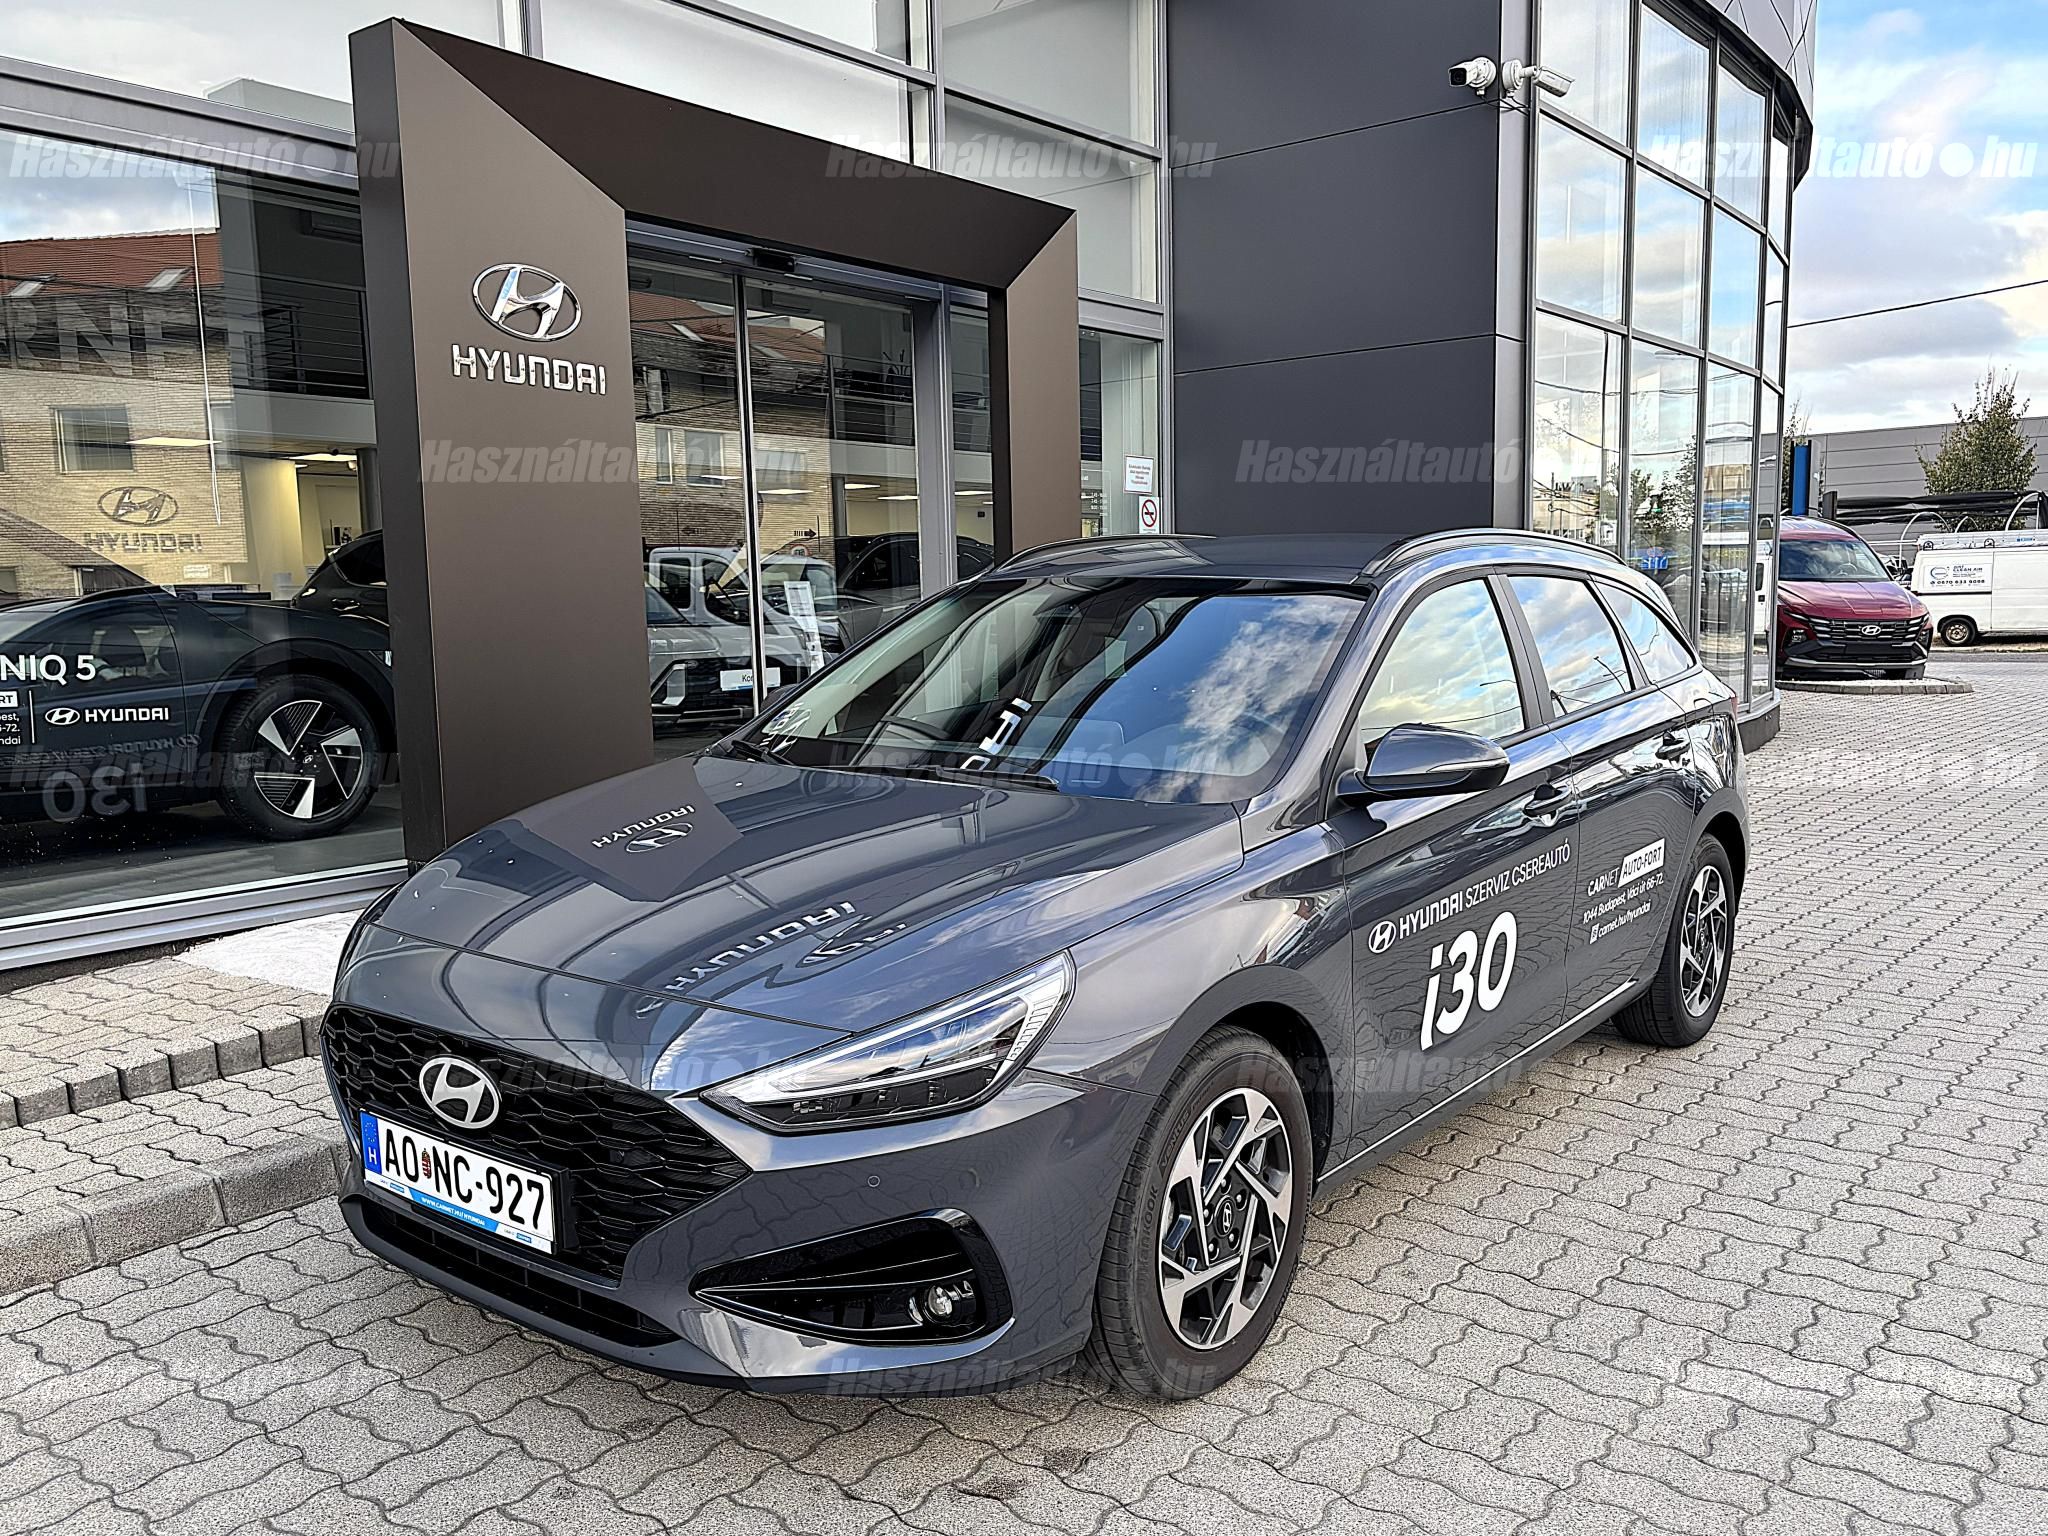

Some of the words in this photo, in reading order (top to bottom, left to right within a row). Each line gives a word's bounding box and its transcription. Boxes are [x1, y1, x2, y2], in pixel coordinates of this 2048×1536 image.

[452, 344, 608, 396] HYUNDAI
[76, 654, 96, 681] 5
[85, 707, 169, 723] HYUNDAI
[1399, 889, 1464, 940] HYUNDAI
[1465, 868, 1512, 909] SZERVIZ
[1511, 837, 1571, 887] CSEREAUTÓ
[1588, 866, 1620, 897] CARNET
[1622, 846, 1662, 879] AUTO-FORT
[1583, 905, 1598, 925] 1044
[1420, 911, 1518, 1050] i30
[367, 1146, 378, 1166] H
